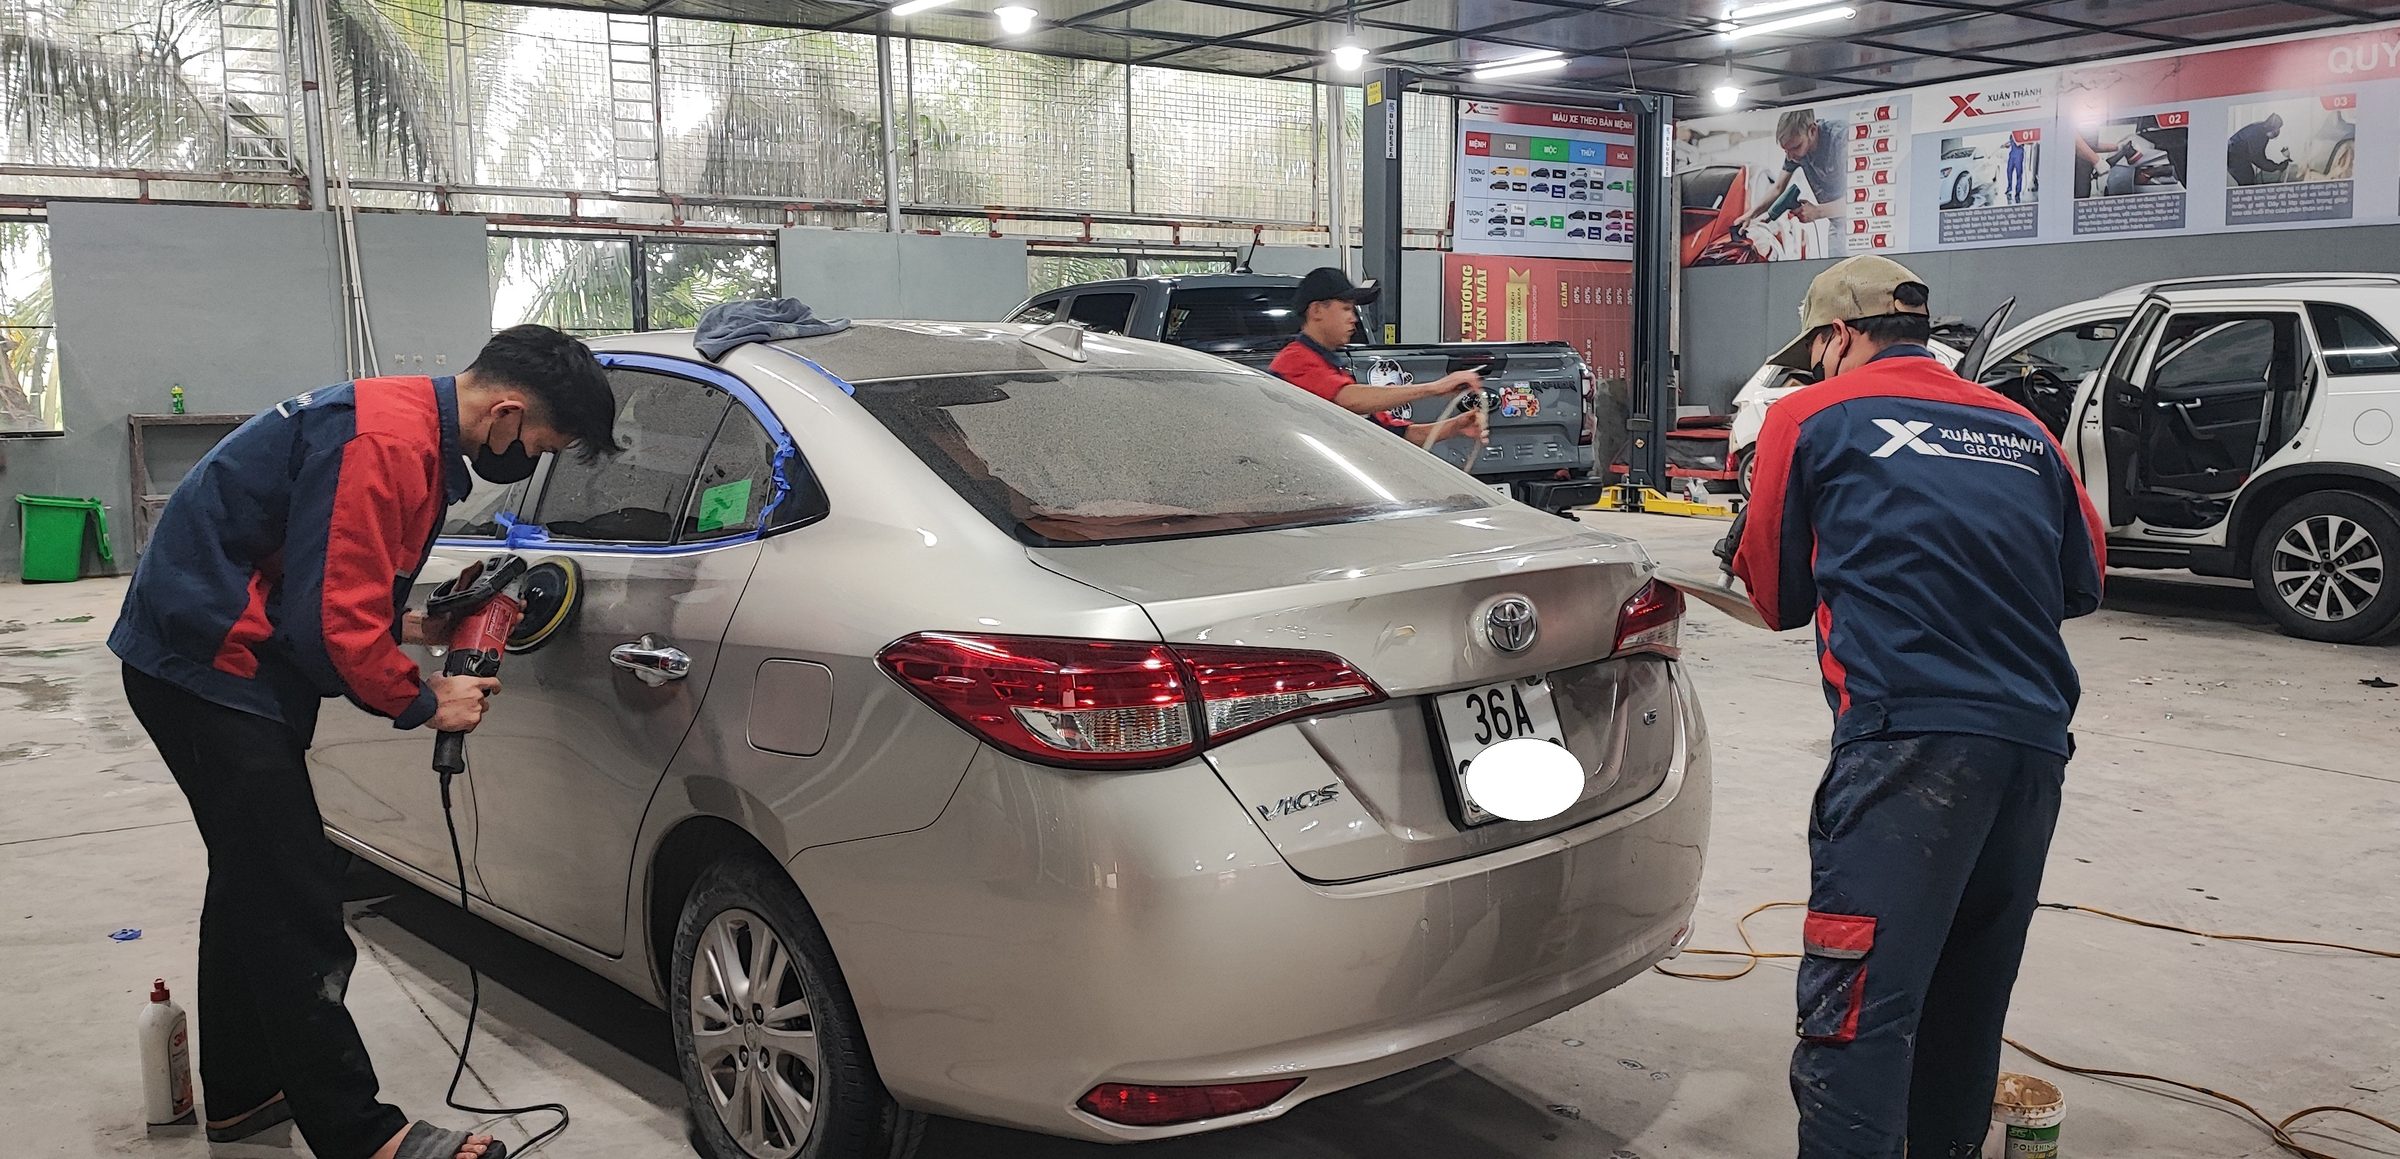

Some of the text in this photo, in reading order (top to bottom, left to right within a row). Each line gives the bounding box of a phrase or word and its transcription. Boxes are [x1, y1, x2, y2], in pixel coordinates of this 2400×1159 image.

[2328, 41, 2400, 74] QUY
[1987, 92, 2010, 102] XUÂN
[2012, 88, 2042, 98] THÀNH
[2334, 97, 2348, 107] 03
[1552, 112, 1633, 130] MÀU XE THEO BẢN MỆNH
[2168, 114, 2182, 124] 02
[2022, 131, 2034, 140] 01
[1544, 145, 1557, 154] MỘC
[1461, 264, 1473, 334] TRƯƠNG
[1473, 307, 1487, 342] YẾN
[1586, 339, 1592, 348] xe
[1938, 428, 1986, 445] XUÂN
[1988, 434, 2044, 455] THÀNH
[1964, 444, 2022, 461] GROUP
[1466, 684, 1534, 745] 36A
[1256, 783, 1339, 821] VIOS
